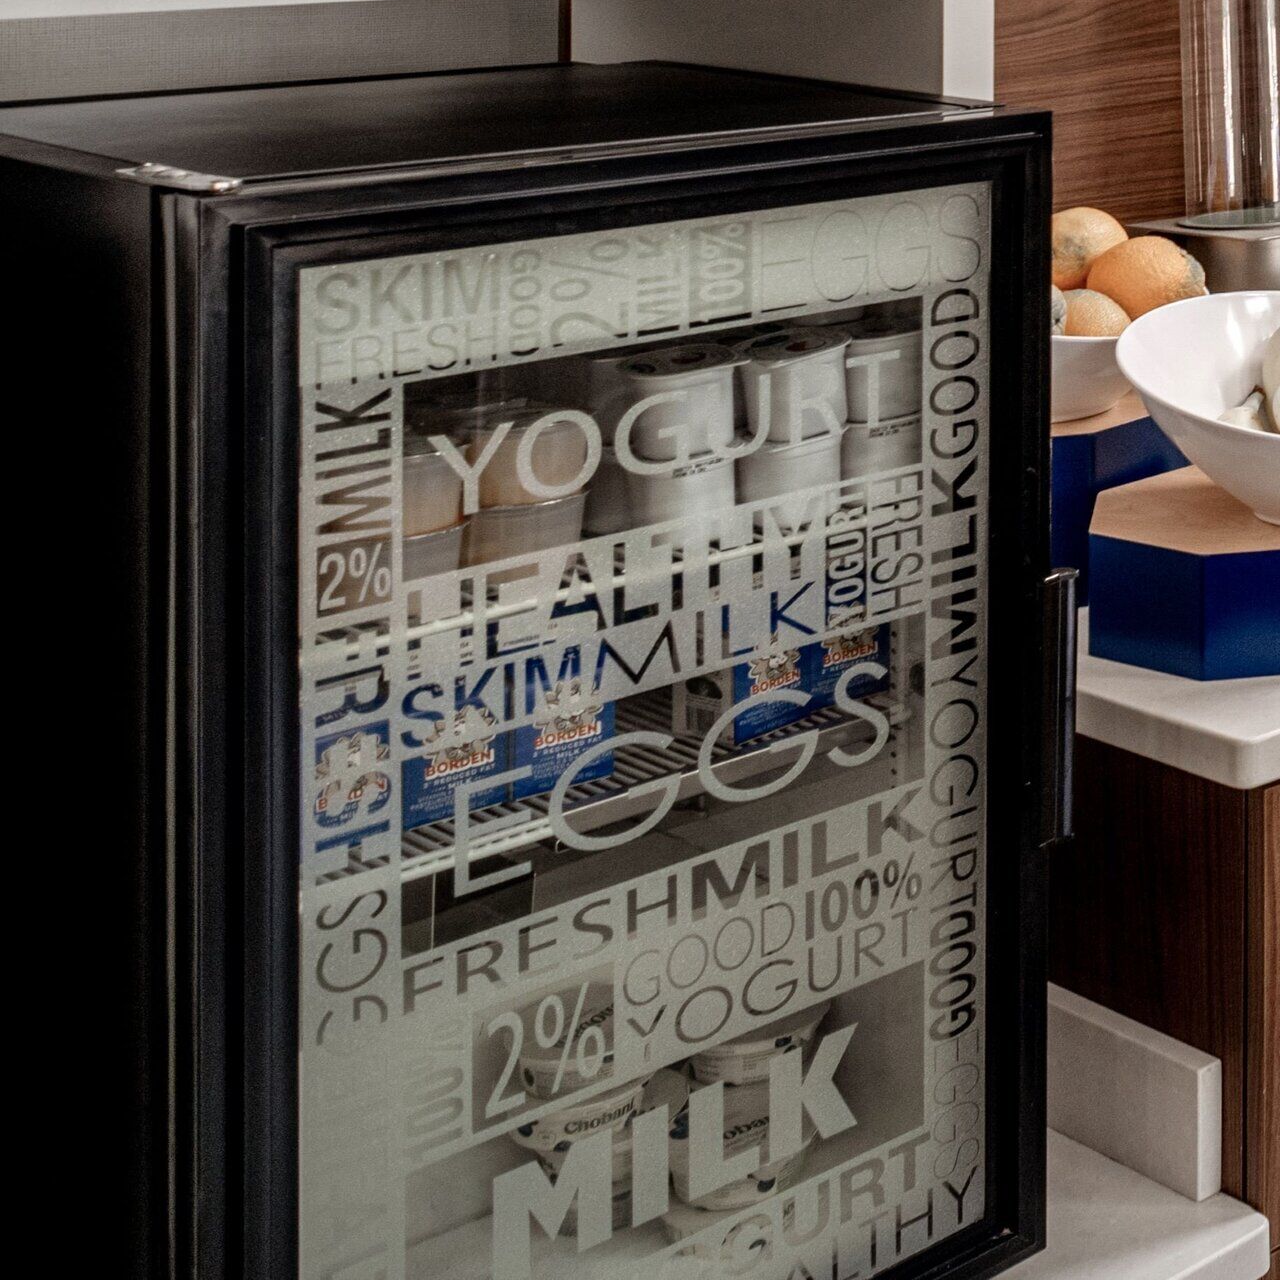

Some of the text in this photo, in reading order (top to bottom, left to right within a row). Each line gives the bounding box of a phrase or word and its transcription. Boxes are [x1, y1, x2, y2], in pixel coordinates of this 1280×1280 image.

[315, 253, 499, 336] SKIM
[315, 315, 498, 391] FRESH
[929, 287, 980, 460] GOOD
[315, 388, 392, 535] MILK
[428, 349, 902, 516] YOGURT
[318, 542, 391, 611] 2%
[930, 456, 979, 660] MILK
[752, 670, 801, 695] BORDEN
[823, 642, 877, 666] BORDEN
[424, 750, 492, 778] BORDEN
[455, 661, 890, 898] EGGS
[534, 723, 600, 748] BORDEN
[315, 888, 390, 1047] GGS
[484, 980, 607, 1119] 2%
[492, 1021, 859, 1280] MILK
[563, 1097, 636, 1136] Chobani
[787, 1164, 979, 1280] ALTHY
